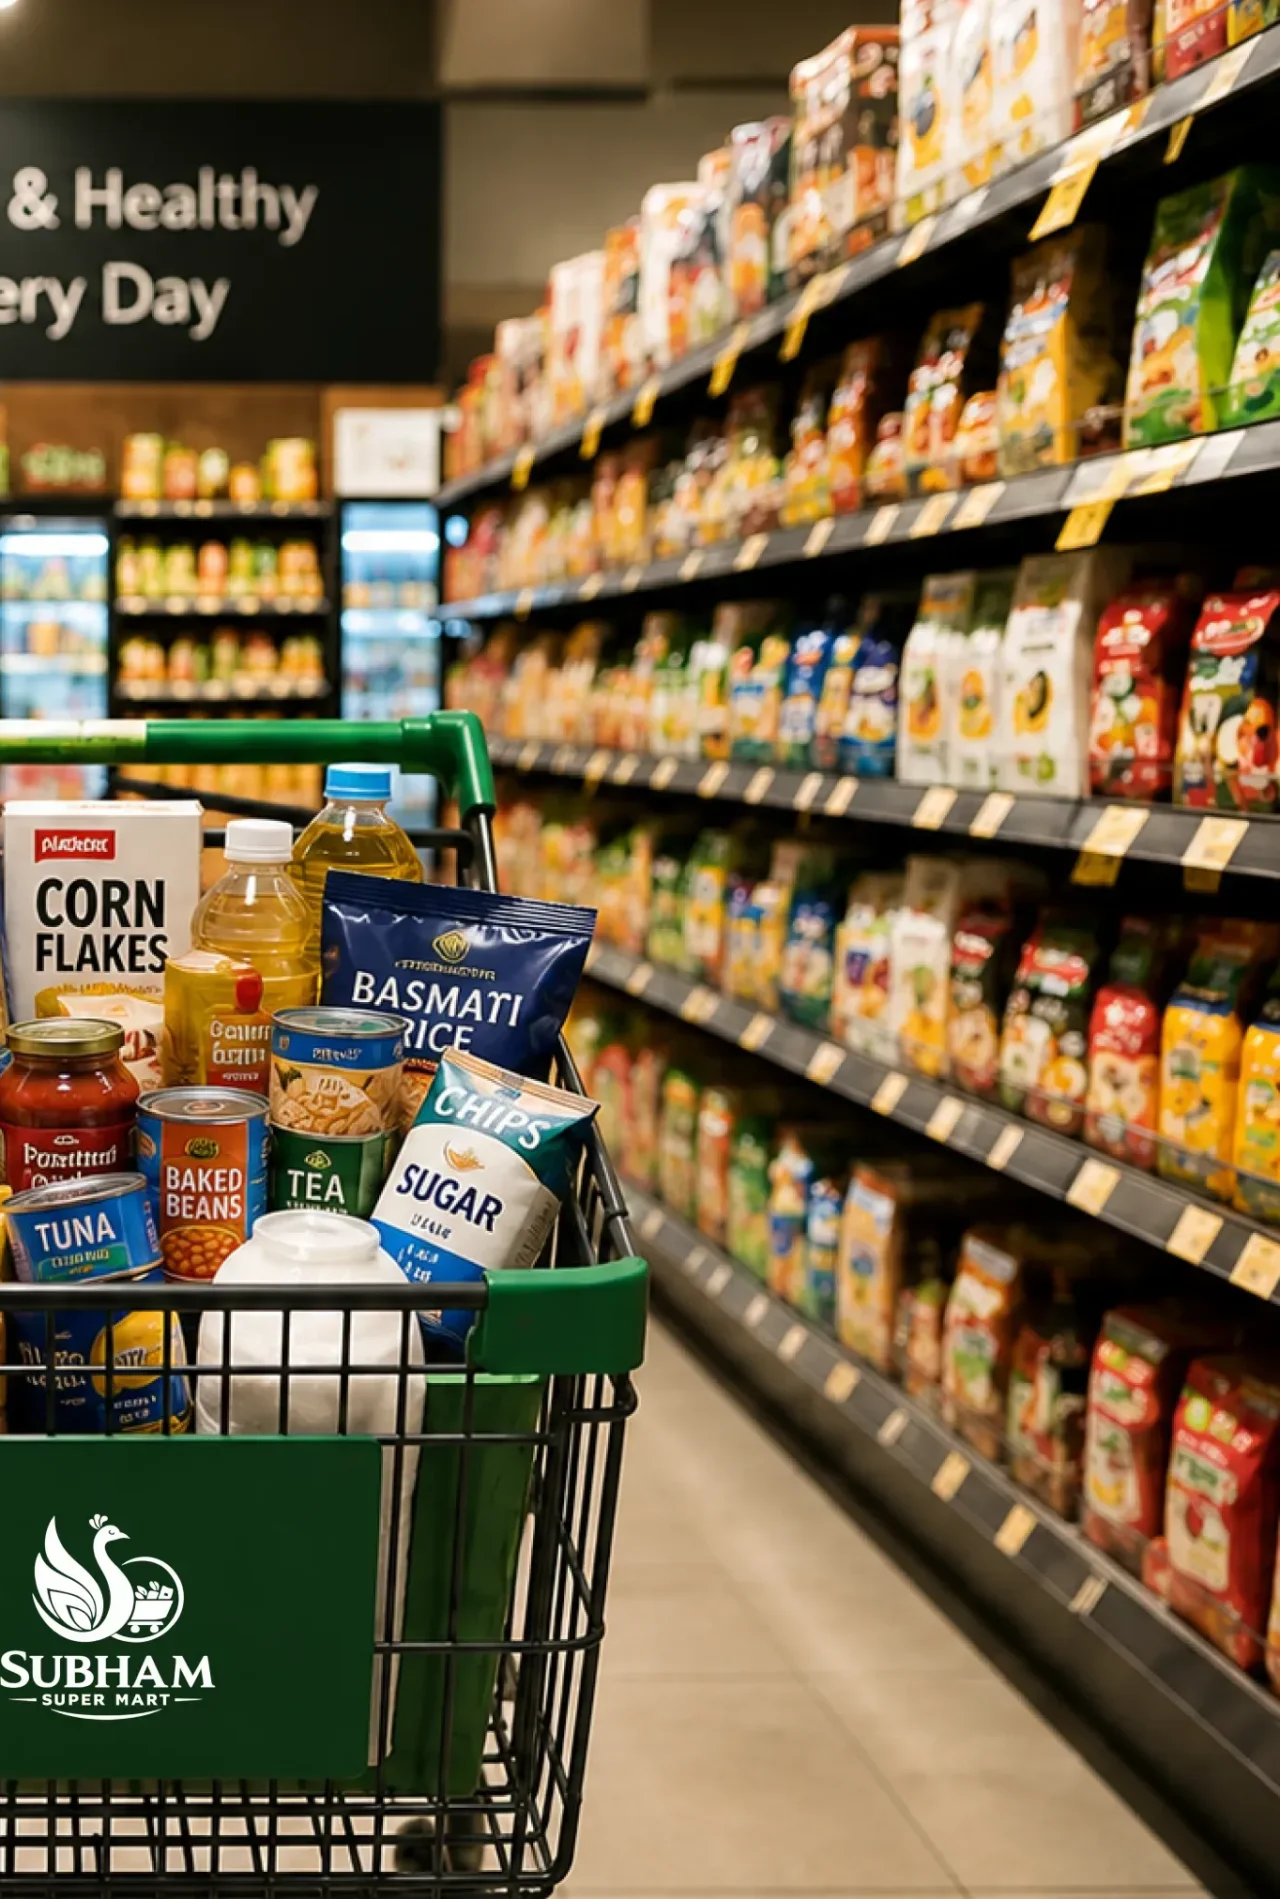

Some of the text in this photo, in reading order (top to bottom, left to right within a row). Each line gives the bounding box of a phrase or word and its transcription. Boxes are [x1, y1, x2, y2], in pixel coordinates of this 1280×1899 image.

[8, 166, 60, 231] &
[74, 165, 319, 246] Healthy
[102, 261, 230, 340] Day
[36, 877, 165, 928] CORN
[36, 933, 169, 973] FLAKES
[351, 970, 524, 1028] BASMATI
[434, 1085, 552, 1150] CHIPS
[166, 1166, 243, 1193] BAKED
[287, 1168, 346, 1204] TEA
[396, 1163, 503, 1233] SUGAR
[166, 1194, 242, 1221] BEANS
[34, 1212, 117, 1252] TUNA
[0, 1650, 216, 1688] SUBHAM
[42, 1693, 171, 1707] SUPER MART
